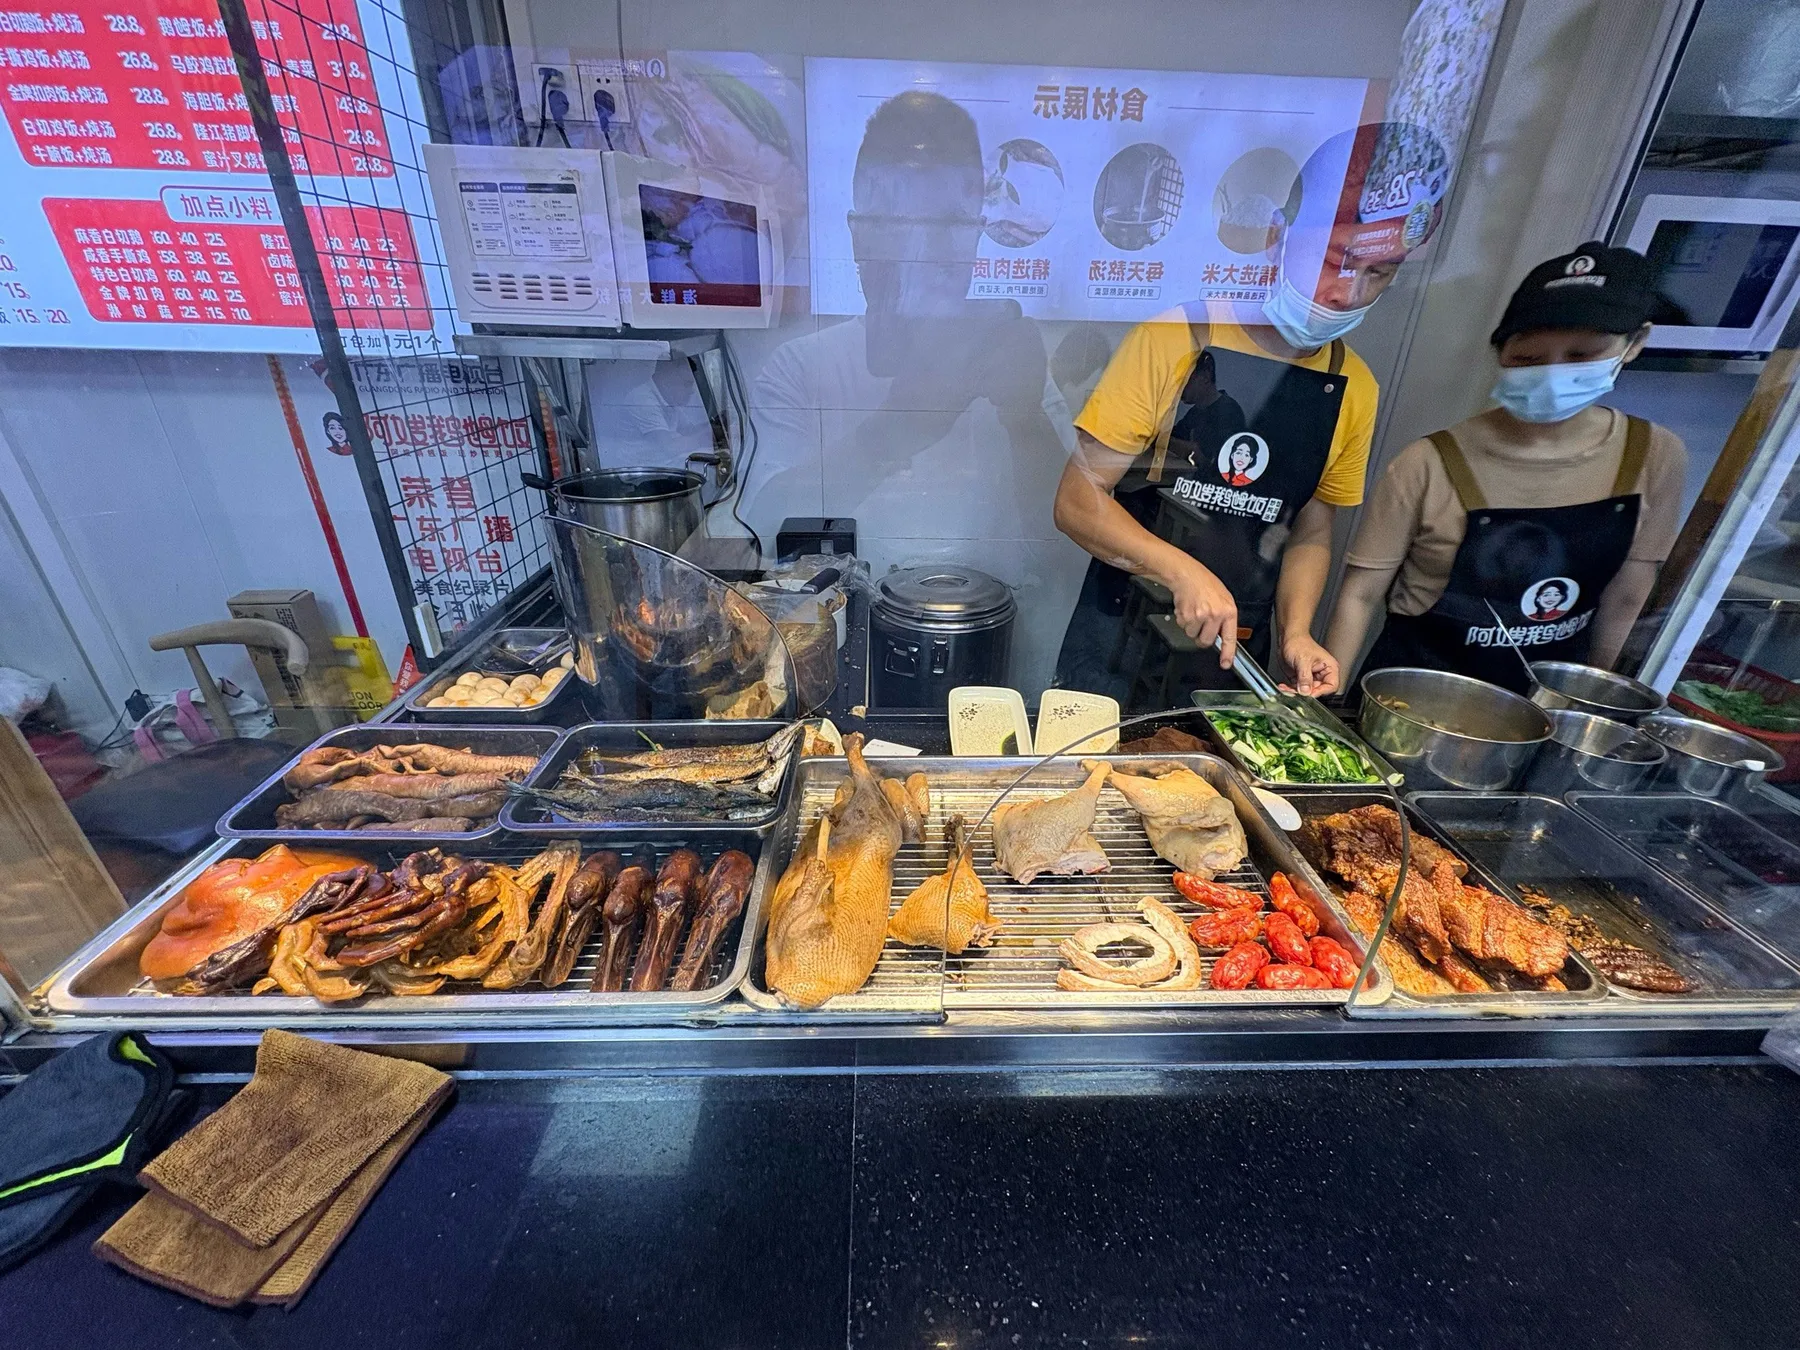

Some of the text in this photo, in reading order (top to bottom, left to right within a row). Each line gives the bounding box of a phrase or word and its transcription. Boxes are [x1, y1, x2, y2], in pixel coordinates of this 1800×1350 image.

[180, 193, 272, 220] 加点小料
[359, 386, 413, 394] GUANGDONG
[415, 386, 440, 394] RADIO
[400, 476, 477, 508] 荣登
[408, 547, 502, 573] 电视台
[414, 579, 509, 597] 美食纪录片
